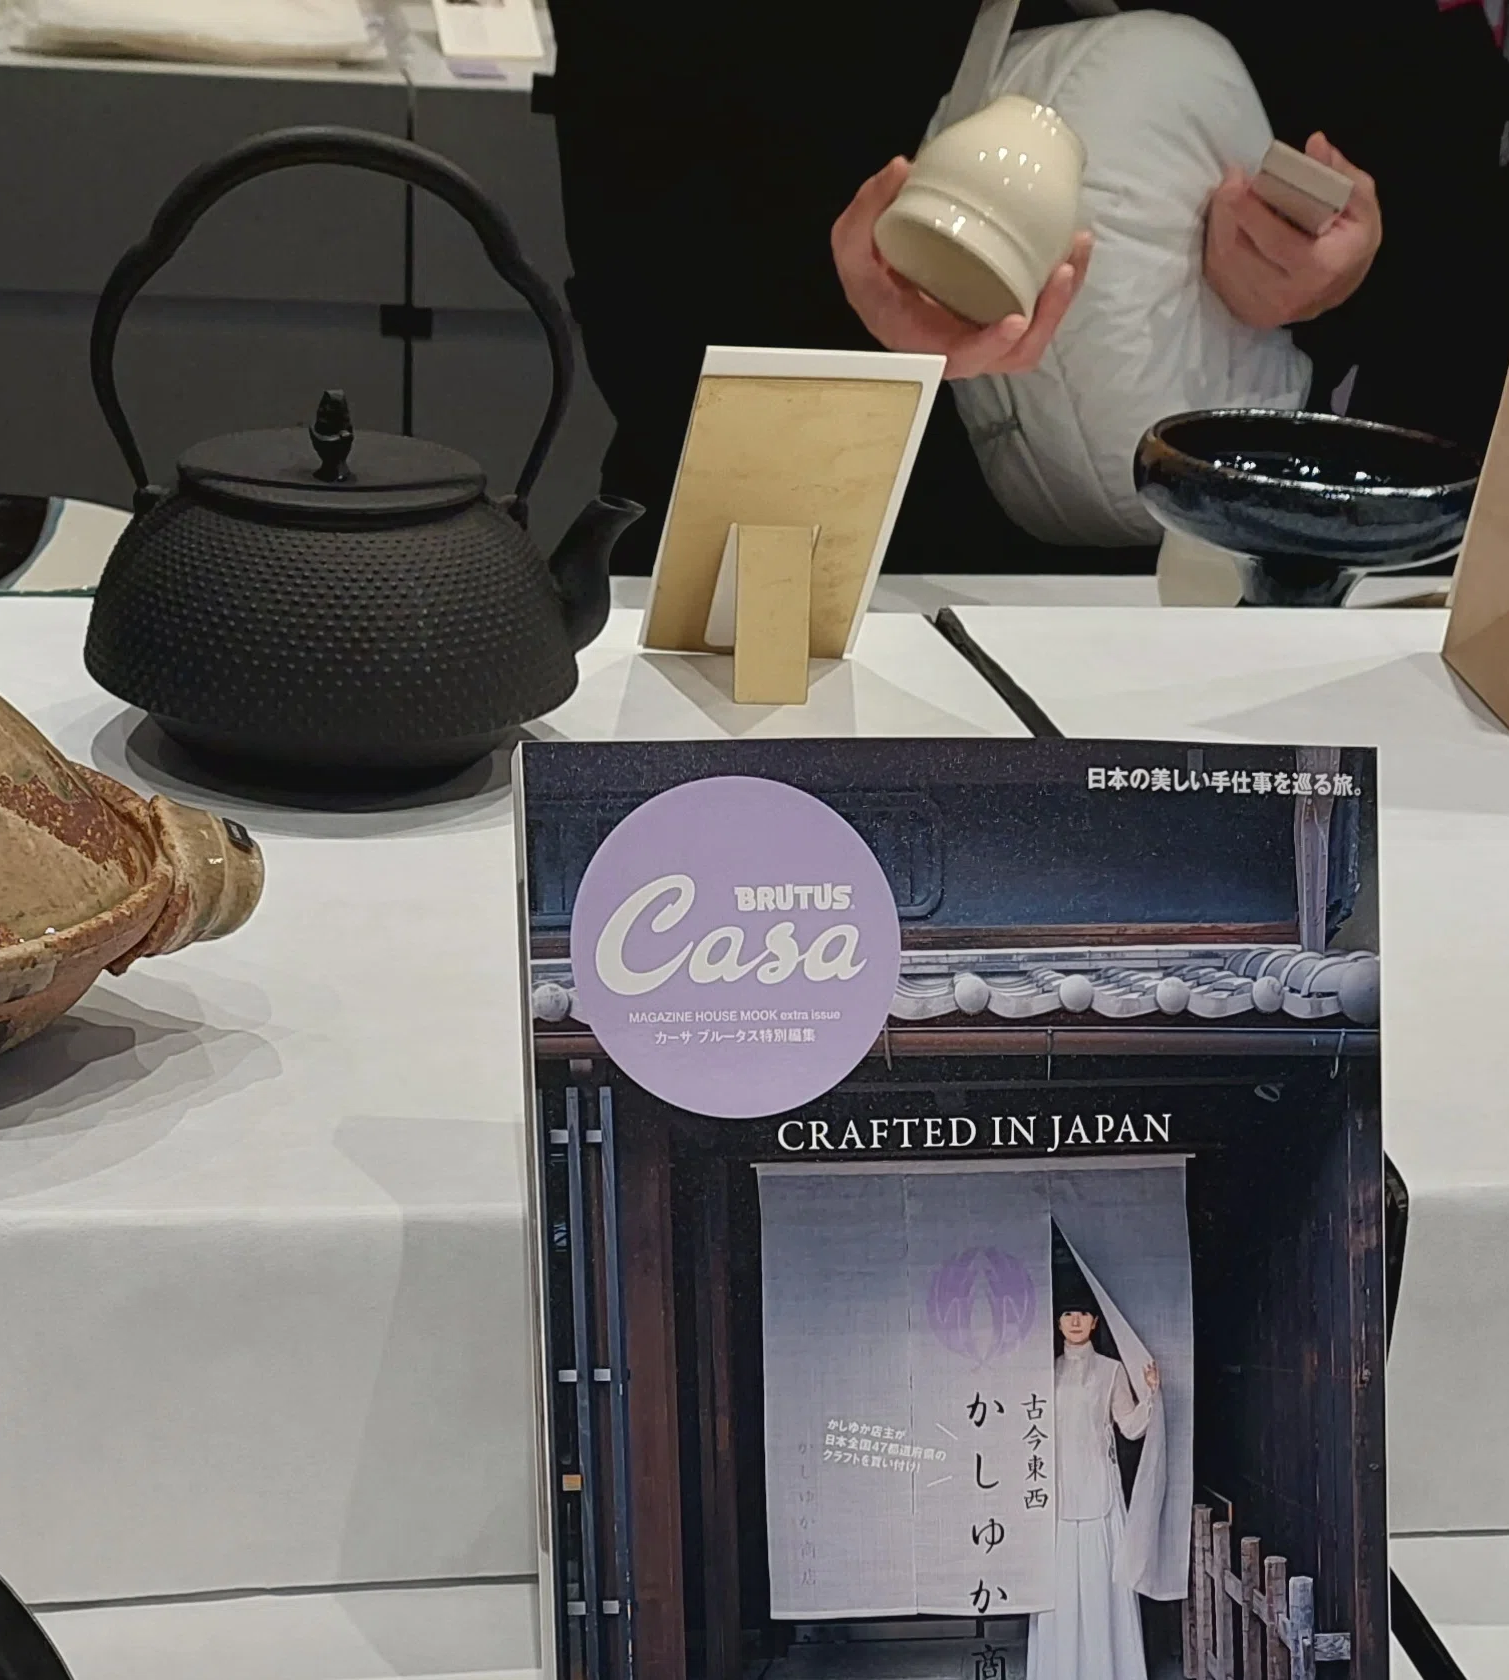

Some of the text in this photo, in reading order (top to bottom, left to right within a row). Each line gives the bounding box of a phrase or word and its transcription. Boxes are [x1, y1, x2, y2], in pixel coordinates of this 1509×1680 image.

[1087, 767, 1363, 797] 日本の美しい手仕事を巡る旅。
[734, 882, 852, 912] BRUTUS
[595, 874, 868, 996] Casa
[629, 1009, 841, 1023] MAGAZINE HOUSE MOOK extra issue
[655, 1028, 816, 1045] カーサ ブルータス特別編集
[777, 1112, 1173, 1154] CRAFTED IN JAPAN
[827, 1419, 906, 1440] かしゆか店主が
[825, 1433, 947, 1462] 日本全国47都道府県の
[1020, 1392, 1049, 1511] 古今東西
